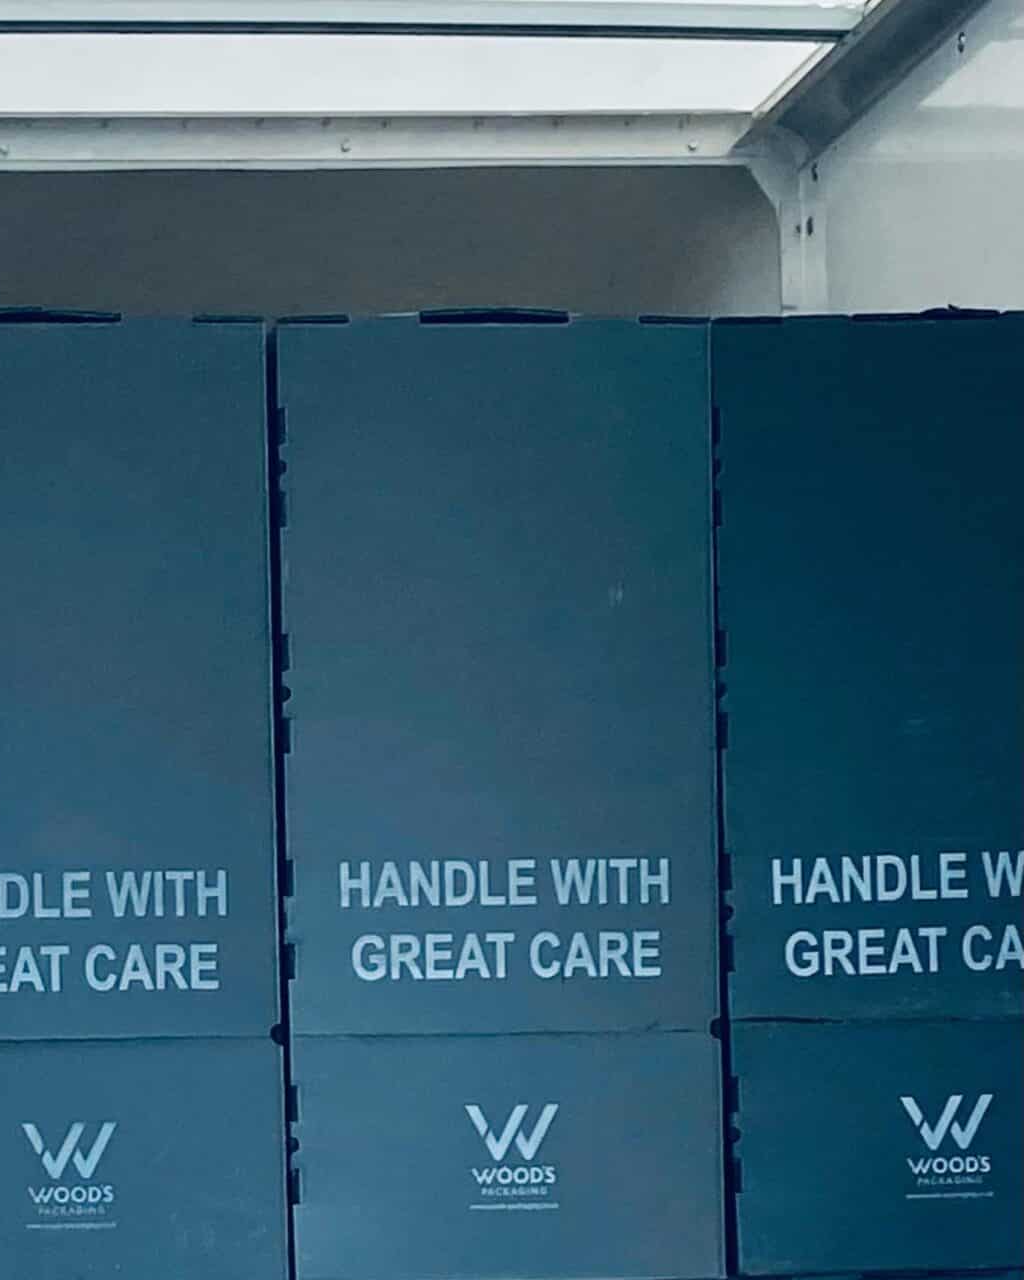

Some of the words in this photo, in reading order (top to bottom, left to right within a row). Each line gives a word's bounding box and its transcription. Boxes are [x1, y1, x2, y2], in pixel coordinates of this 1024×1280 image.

[106, 870, 226, 917] WITH
[340, 860, 536, 907] HANDLE
[551, 859, 668, 904] WITH
[772, 852, 968, 905] HANDLE
[86, 944, 218, 991] CARE
[352, 933, 514, 980] GREAT
[530, 932, 661, 978] CARE
[786, 928, 946, 976] GREAT
[963, 925, 1024, 970] CA
[472, 1166, 556, 1185] WOOD'S
[907, 1155, 991, 1175] WOOD'S
[28, 1184, 114, 1204] WOOD'S
